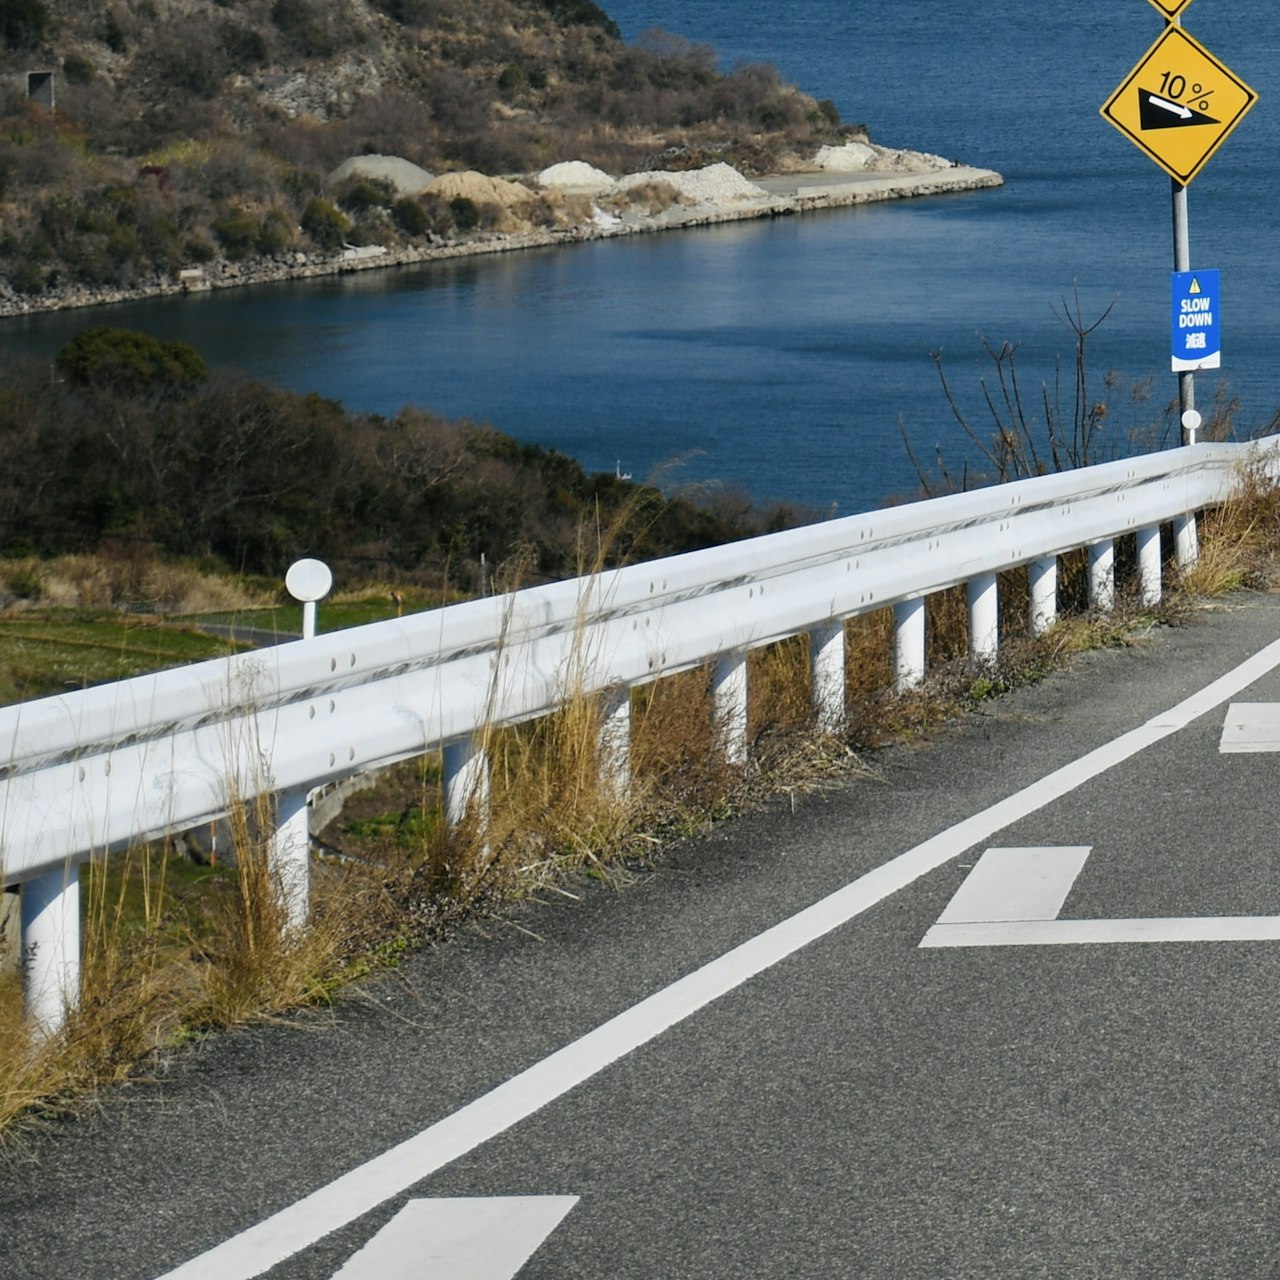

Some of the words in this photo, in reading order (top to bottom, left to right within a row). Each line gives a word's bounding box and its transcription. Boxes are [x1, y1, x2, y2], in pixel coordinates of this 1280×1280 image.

[1159, 71, 1215, 111] 10%
[1181, 297, 1211, 312] SLOW
[1179, 312, 1213, 328] DOWN
